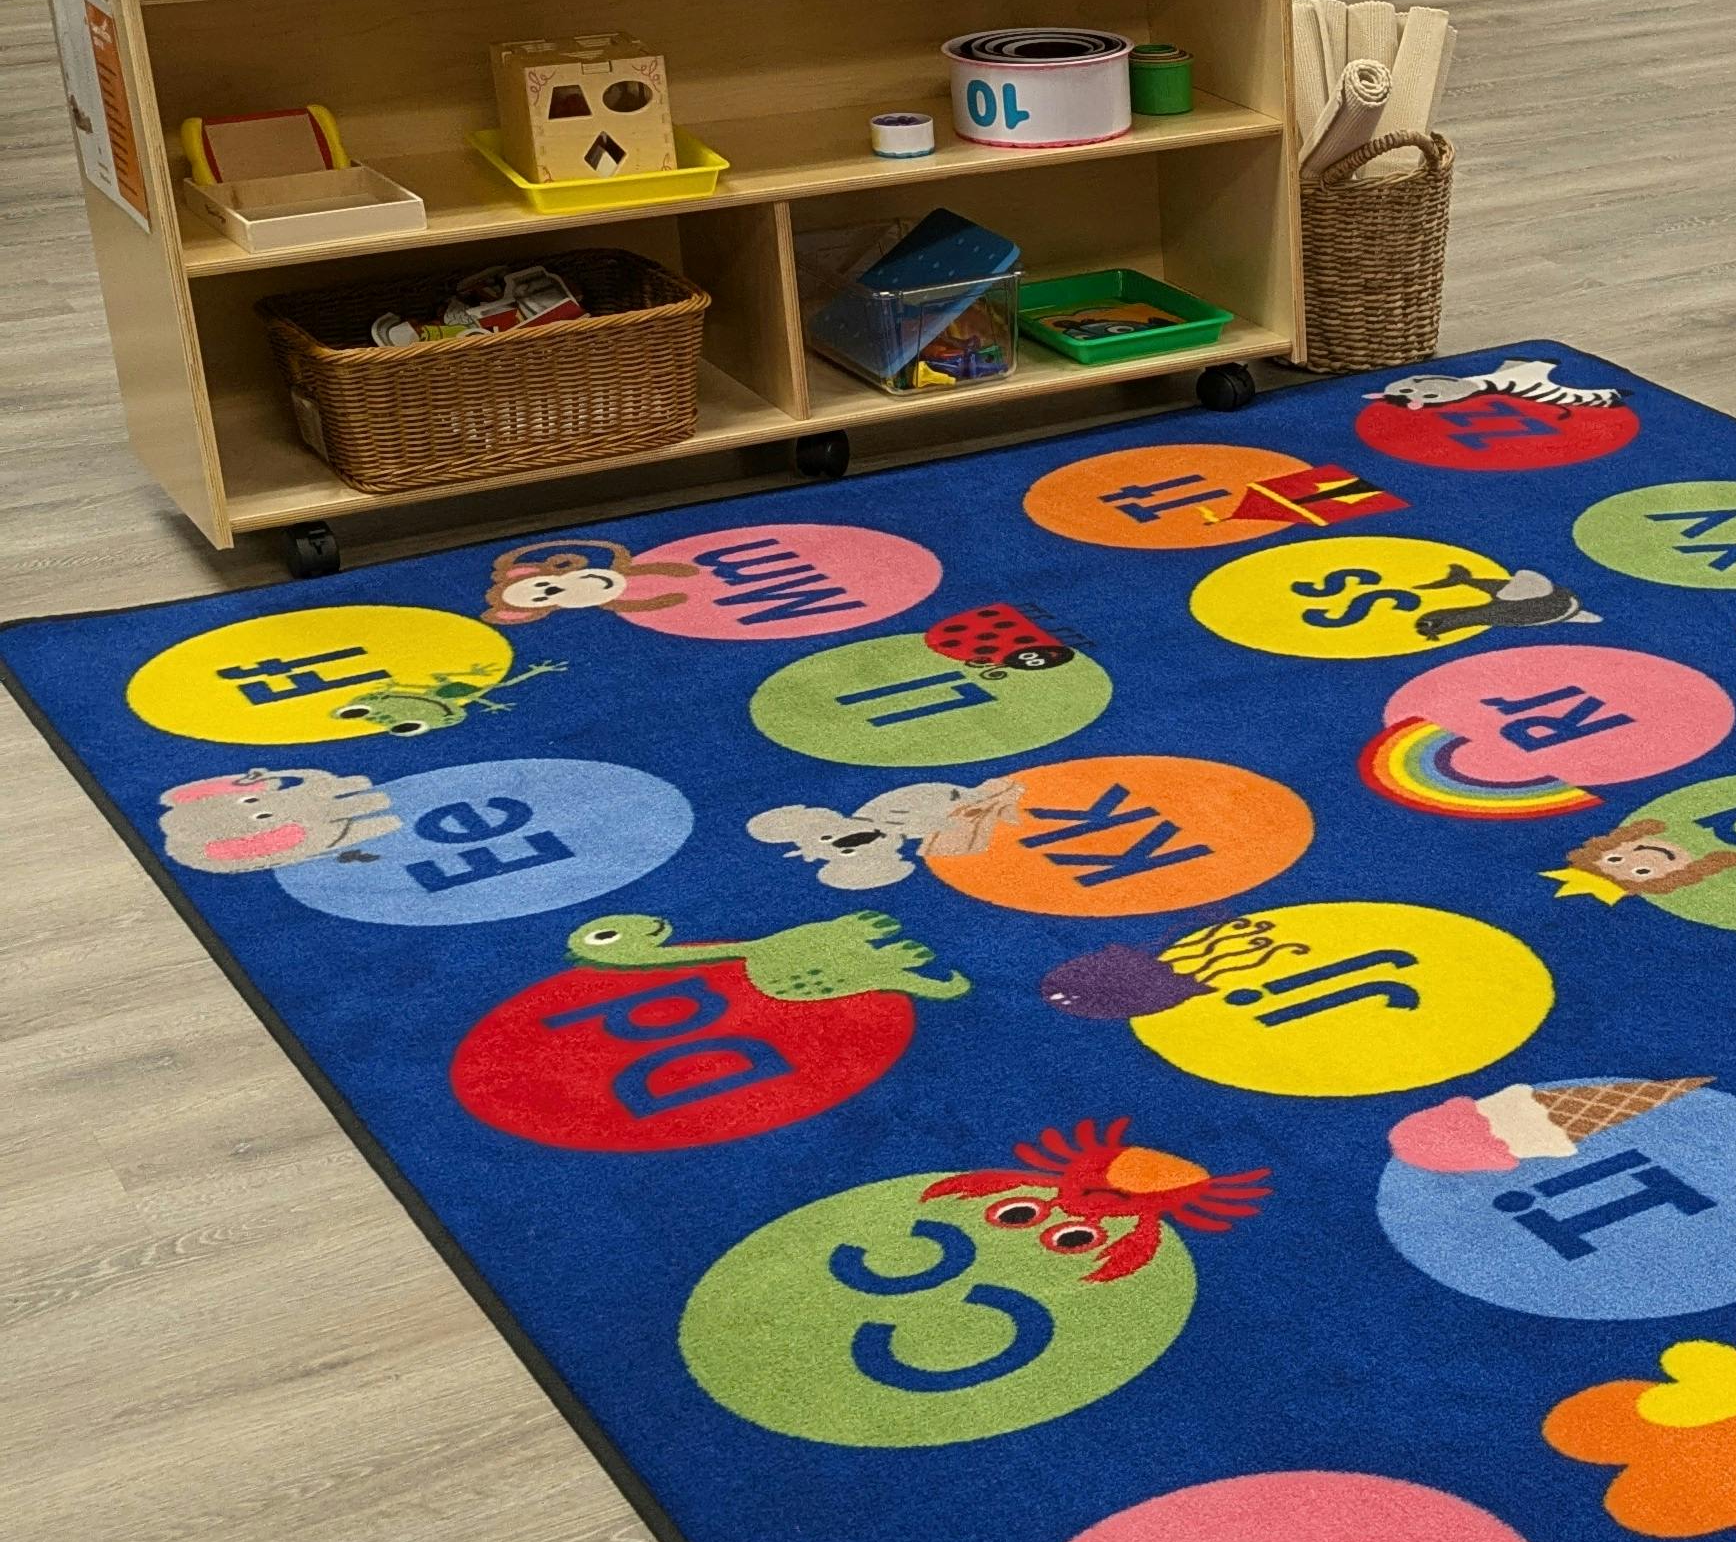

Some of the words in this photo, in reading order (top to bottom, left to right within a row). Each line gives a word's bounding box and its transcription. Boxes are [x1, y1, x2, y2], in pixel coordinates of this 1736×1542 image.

[967, 78, 1030, 130] 10
[1434, 401, 1564, 450] Zz
[1097, 474, 1231, 523] Tt
[692, 538, 875, 626] Mm
[1290, 568, 1420, 628] Ss
[217, 647, 391, 707] Ff
[837, 670, 998, 728] Ll
[1480, 685, 1636, 752] Rr
[408, 796, 576, 895] Ee
[1018, 783, 1213, 887] Kk
[1223, 949, 1421, 1027] Jj
[543, 977, 797, 1114] Dd
[1492, 1148, 1719, 1261] Ii
[828, 1219, 1055, 1394] Cc
